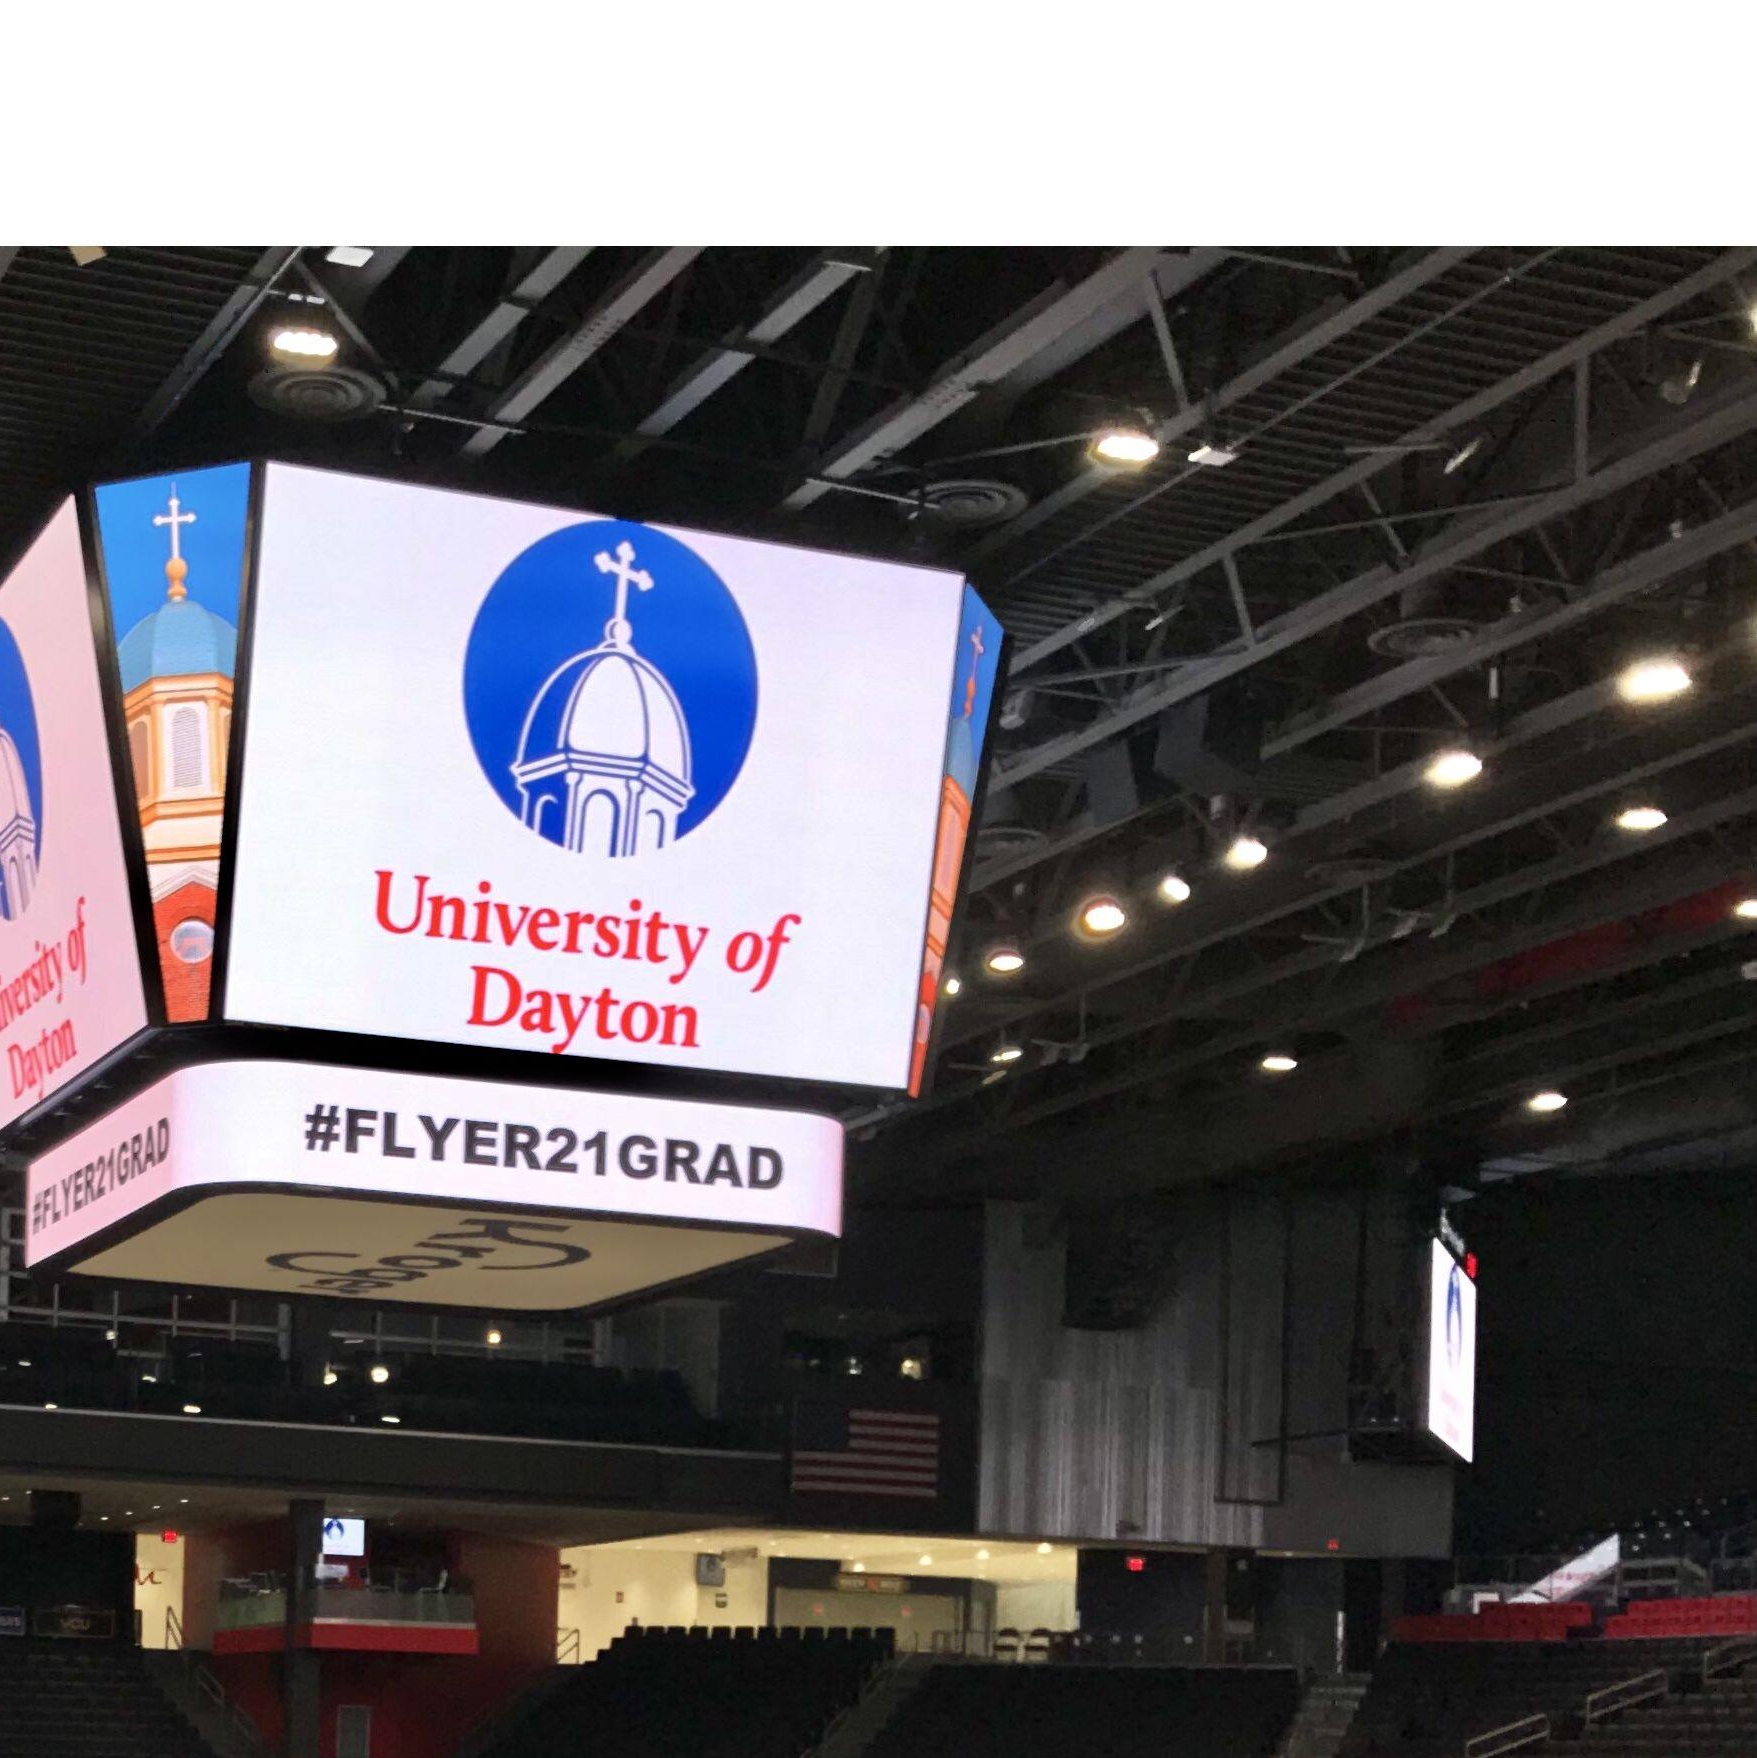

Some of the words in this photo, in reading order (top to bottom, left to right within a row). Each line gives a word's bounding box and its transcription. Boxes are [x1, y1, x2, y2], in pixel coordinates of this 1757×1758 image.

[66, 896, 87, 984] of
[376, 870, 708, 985] University
[726, 914, 802, 992] of
[468, 966, 699, 1054] Dayton
[8, 1014, 78, 1101] Dayton
[31, 1116, 171, 1235] #FLYER21GRAD
[306, 1105, 783, 1189] #FLYER21GRAD
